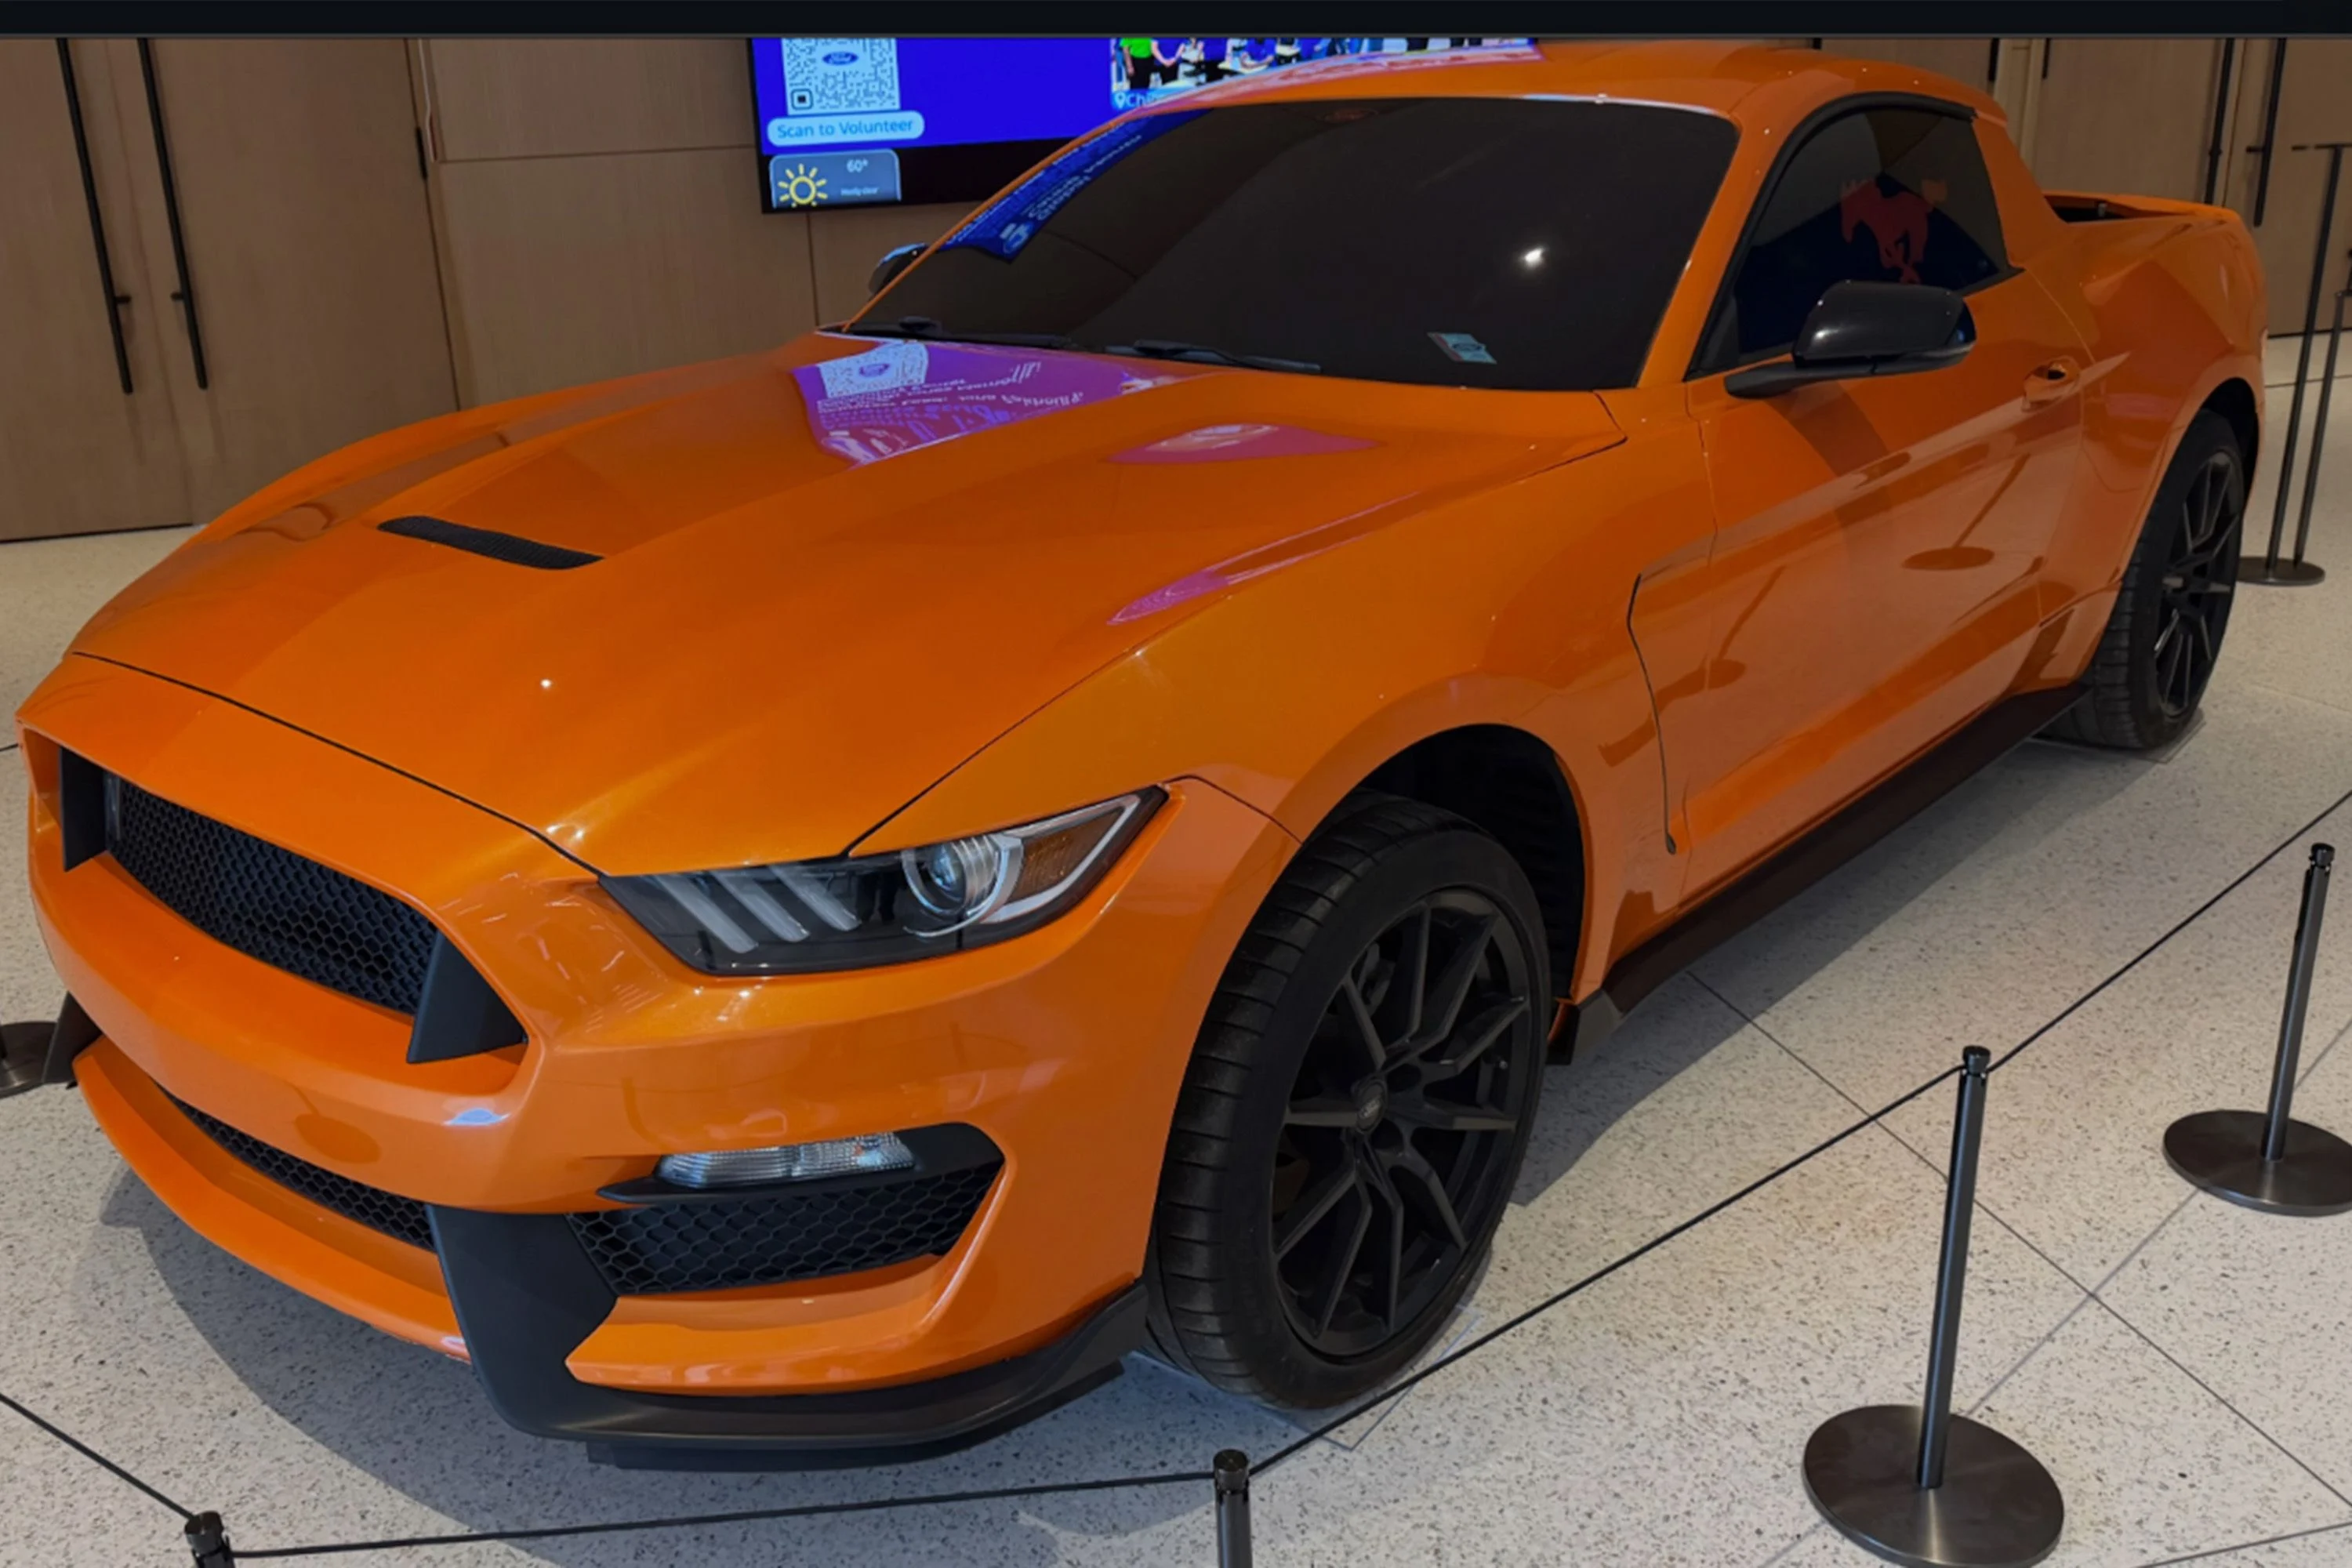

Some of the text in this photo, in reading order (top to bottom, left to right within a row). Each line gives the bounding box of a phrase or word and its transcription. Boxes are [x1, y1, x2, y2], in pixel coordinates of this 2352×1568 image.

[777, 119, 913, 139] Scan to Volunteer
